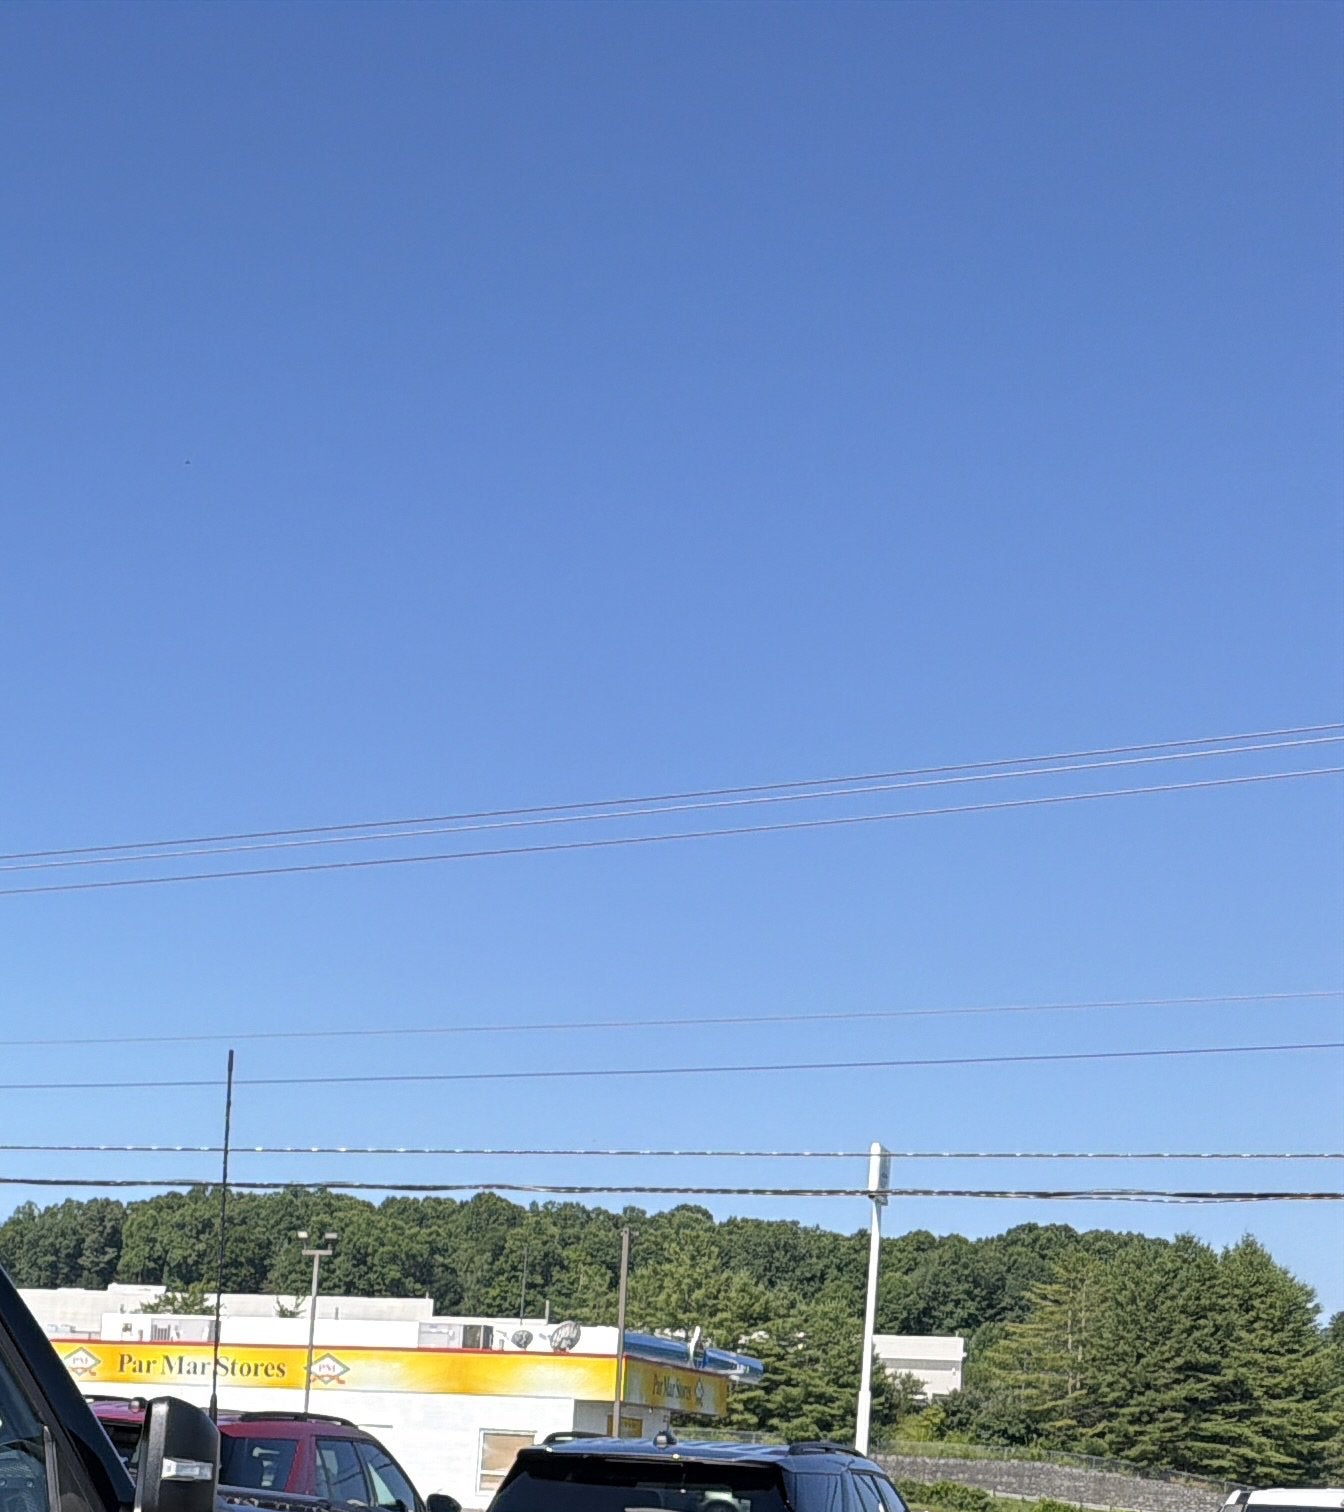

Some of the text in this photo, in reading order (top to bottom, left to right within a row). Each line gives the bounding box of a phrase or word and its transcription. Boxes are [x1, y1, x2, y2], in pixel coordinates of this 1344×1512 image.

[118, 1353, 286, 1378] Par Mar Stores
